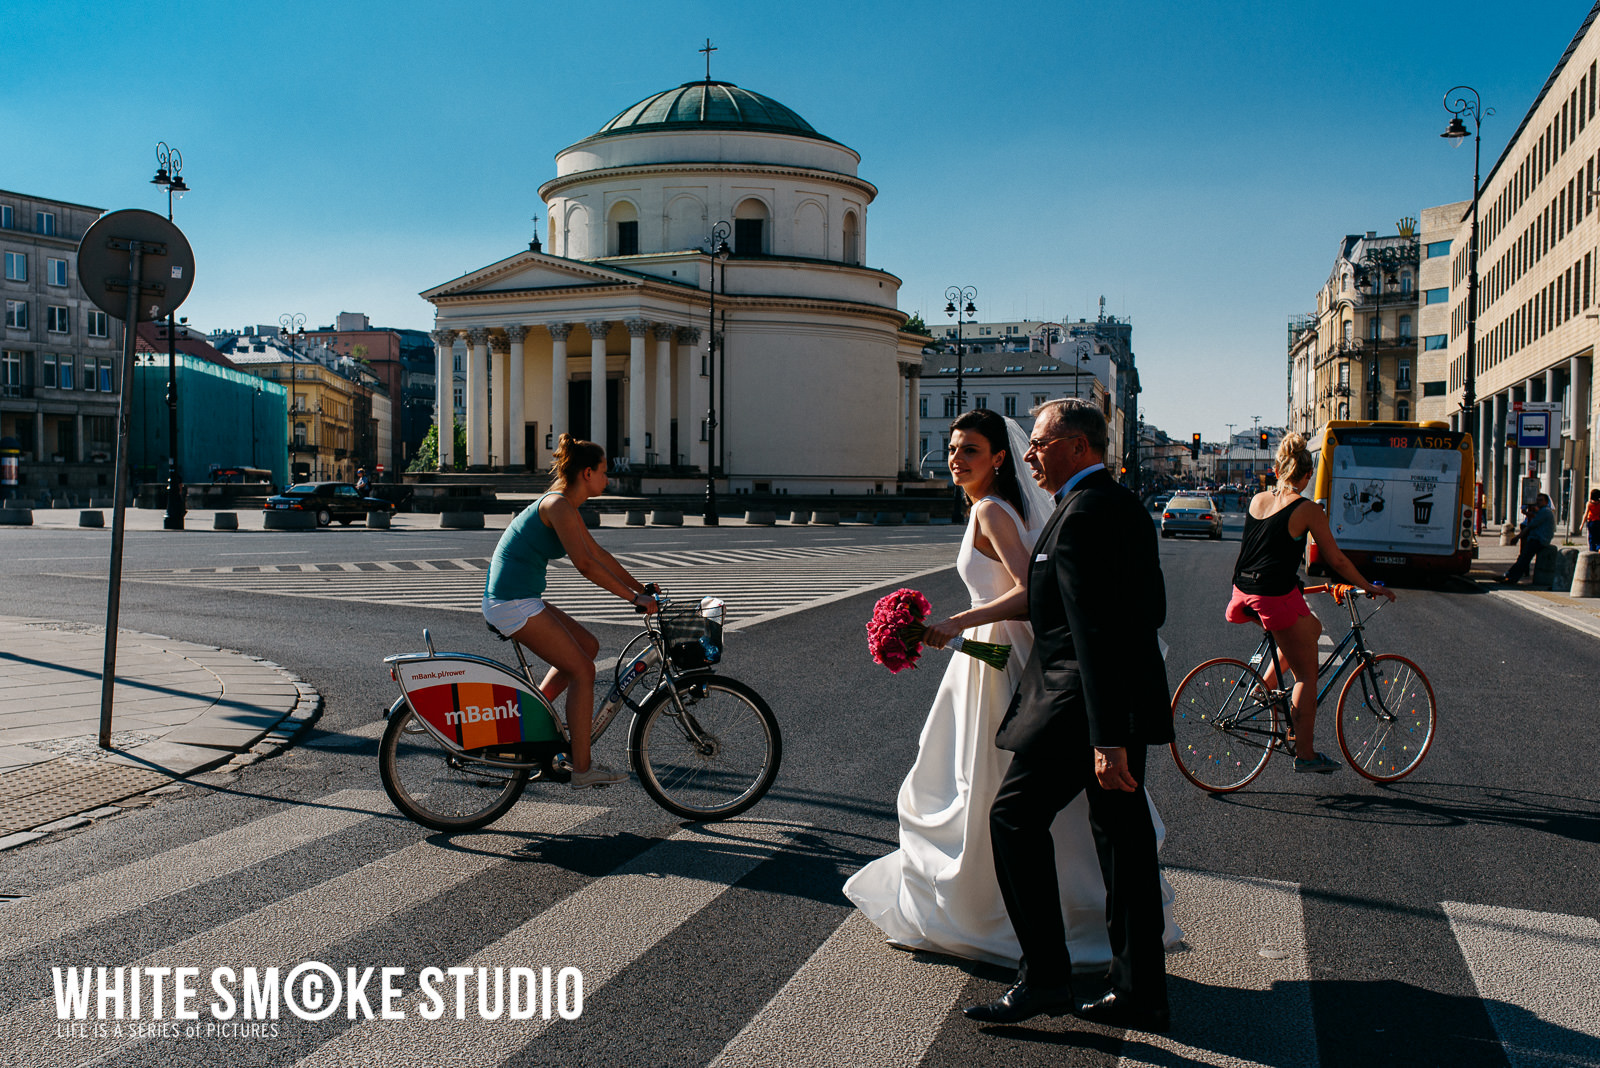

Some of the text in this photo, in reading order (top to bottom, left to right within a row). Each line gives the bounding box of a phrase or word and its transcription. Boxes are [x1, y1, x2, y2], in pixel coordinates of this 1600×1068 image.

[1388, 436, 1408, 448] 108
[1413, 436, 1453, 449] A505
[411, 669, 466, 680] mBank.pl/rower
[616, 671, 636, 695] 0417
[445, 700, 521, 725] mBank
